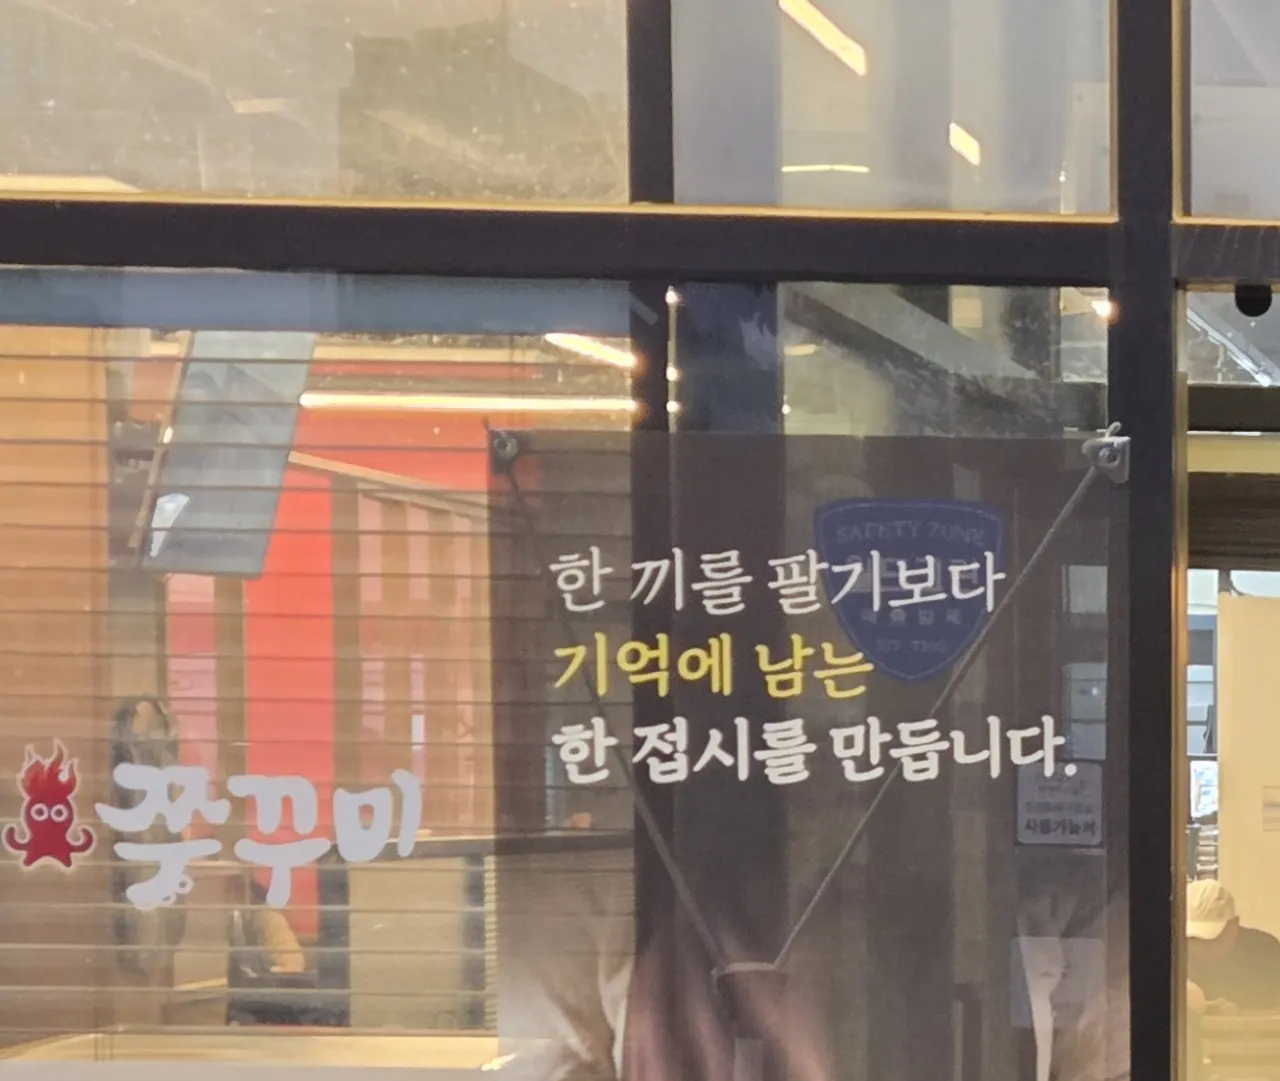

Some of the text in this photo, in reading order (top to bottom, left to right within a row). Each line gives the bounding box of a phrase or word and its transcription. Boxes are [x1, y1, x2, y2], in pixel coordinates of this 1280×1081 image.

[549, 546, 612, 612] 한
[629, 547, 753, 616] 끼를
[767, 550, 1006, 616] 팔기보다
[553, 632, 874, 698] 기억에 남는
[552, 717, 618, 784] 한
[632, 716, 816, 786] 접시를
[95, 762, 423, 909] 쭈꾸미
